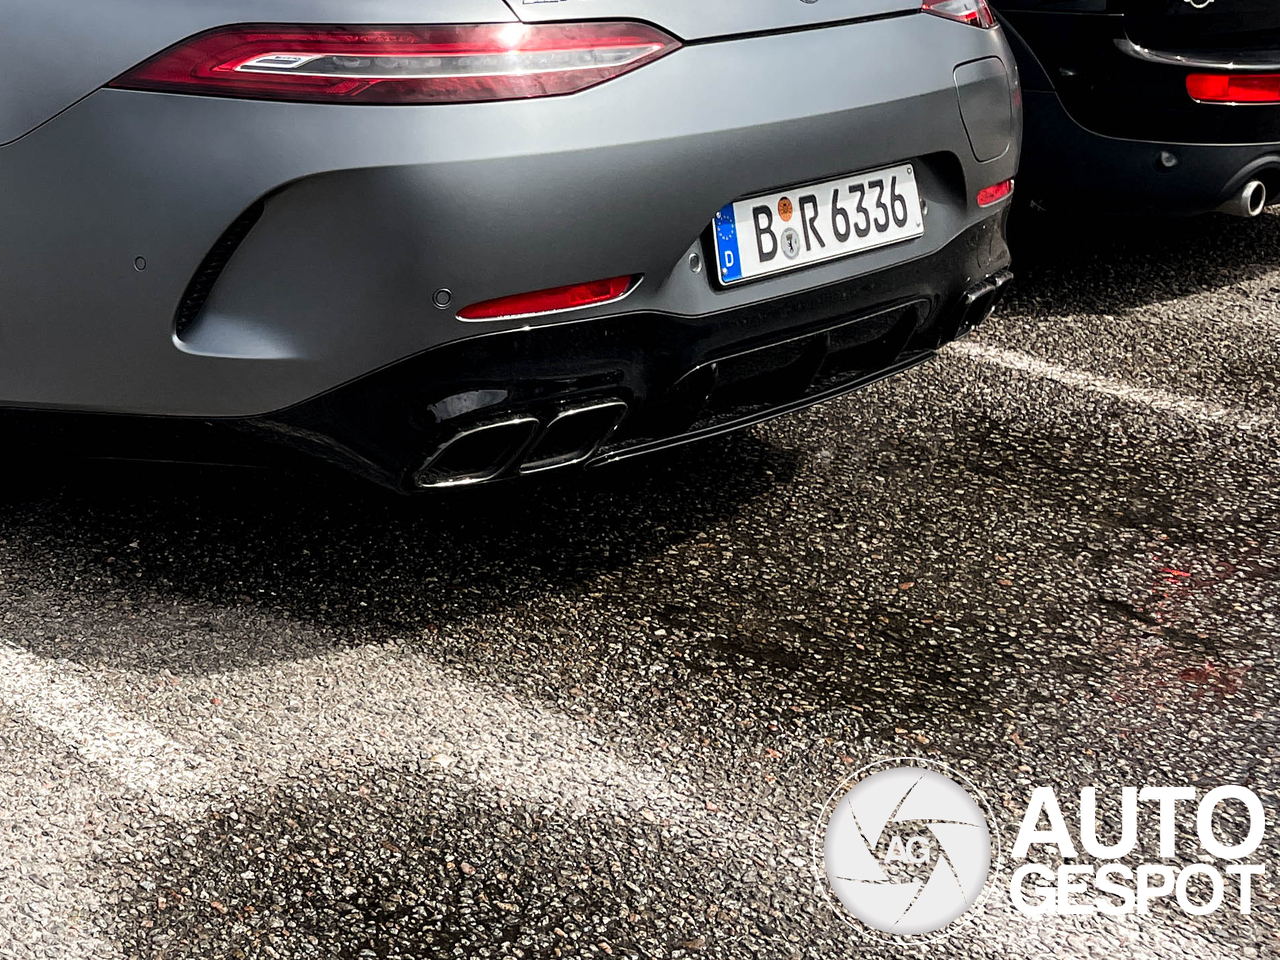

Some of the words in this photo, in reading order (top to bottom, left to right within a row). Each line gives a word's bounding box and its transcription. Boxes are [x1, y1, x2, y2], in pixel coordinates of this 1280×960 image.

[724, 250, 734, 267] D
[752, 204, 778, 263] B
[798, 193, 826, 252] R
[831, 176, 908, 243] 6336
